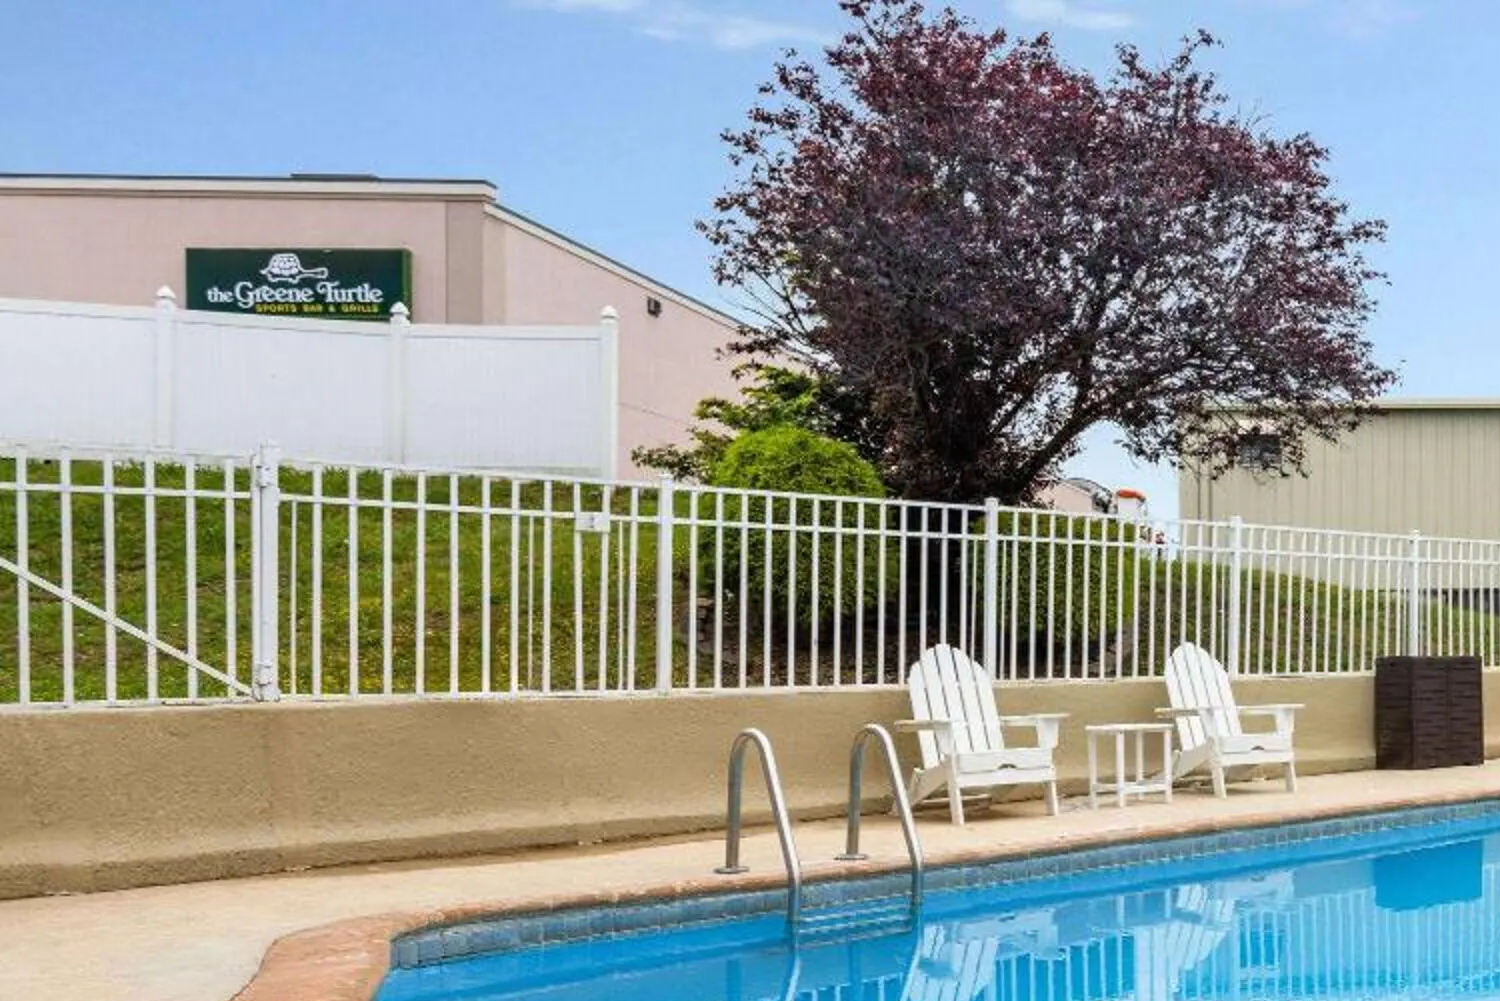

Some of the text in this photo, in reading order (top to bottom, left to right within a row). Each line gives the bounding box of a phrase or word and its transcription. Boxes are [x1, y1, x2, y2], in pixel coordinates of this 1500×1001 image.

[207, 281, 383, 308] the Greene Turtle
[255, 303, 297, 313] SPORTS
[303, 303, 323, 313] BAR
